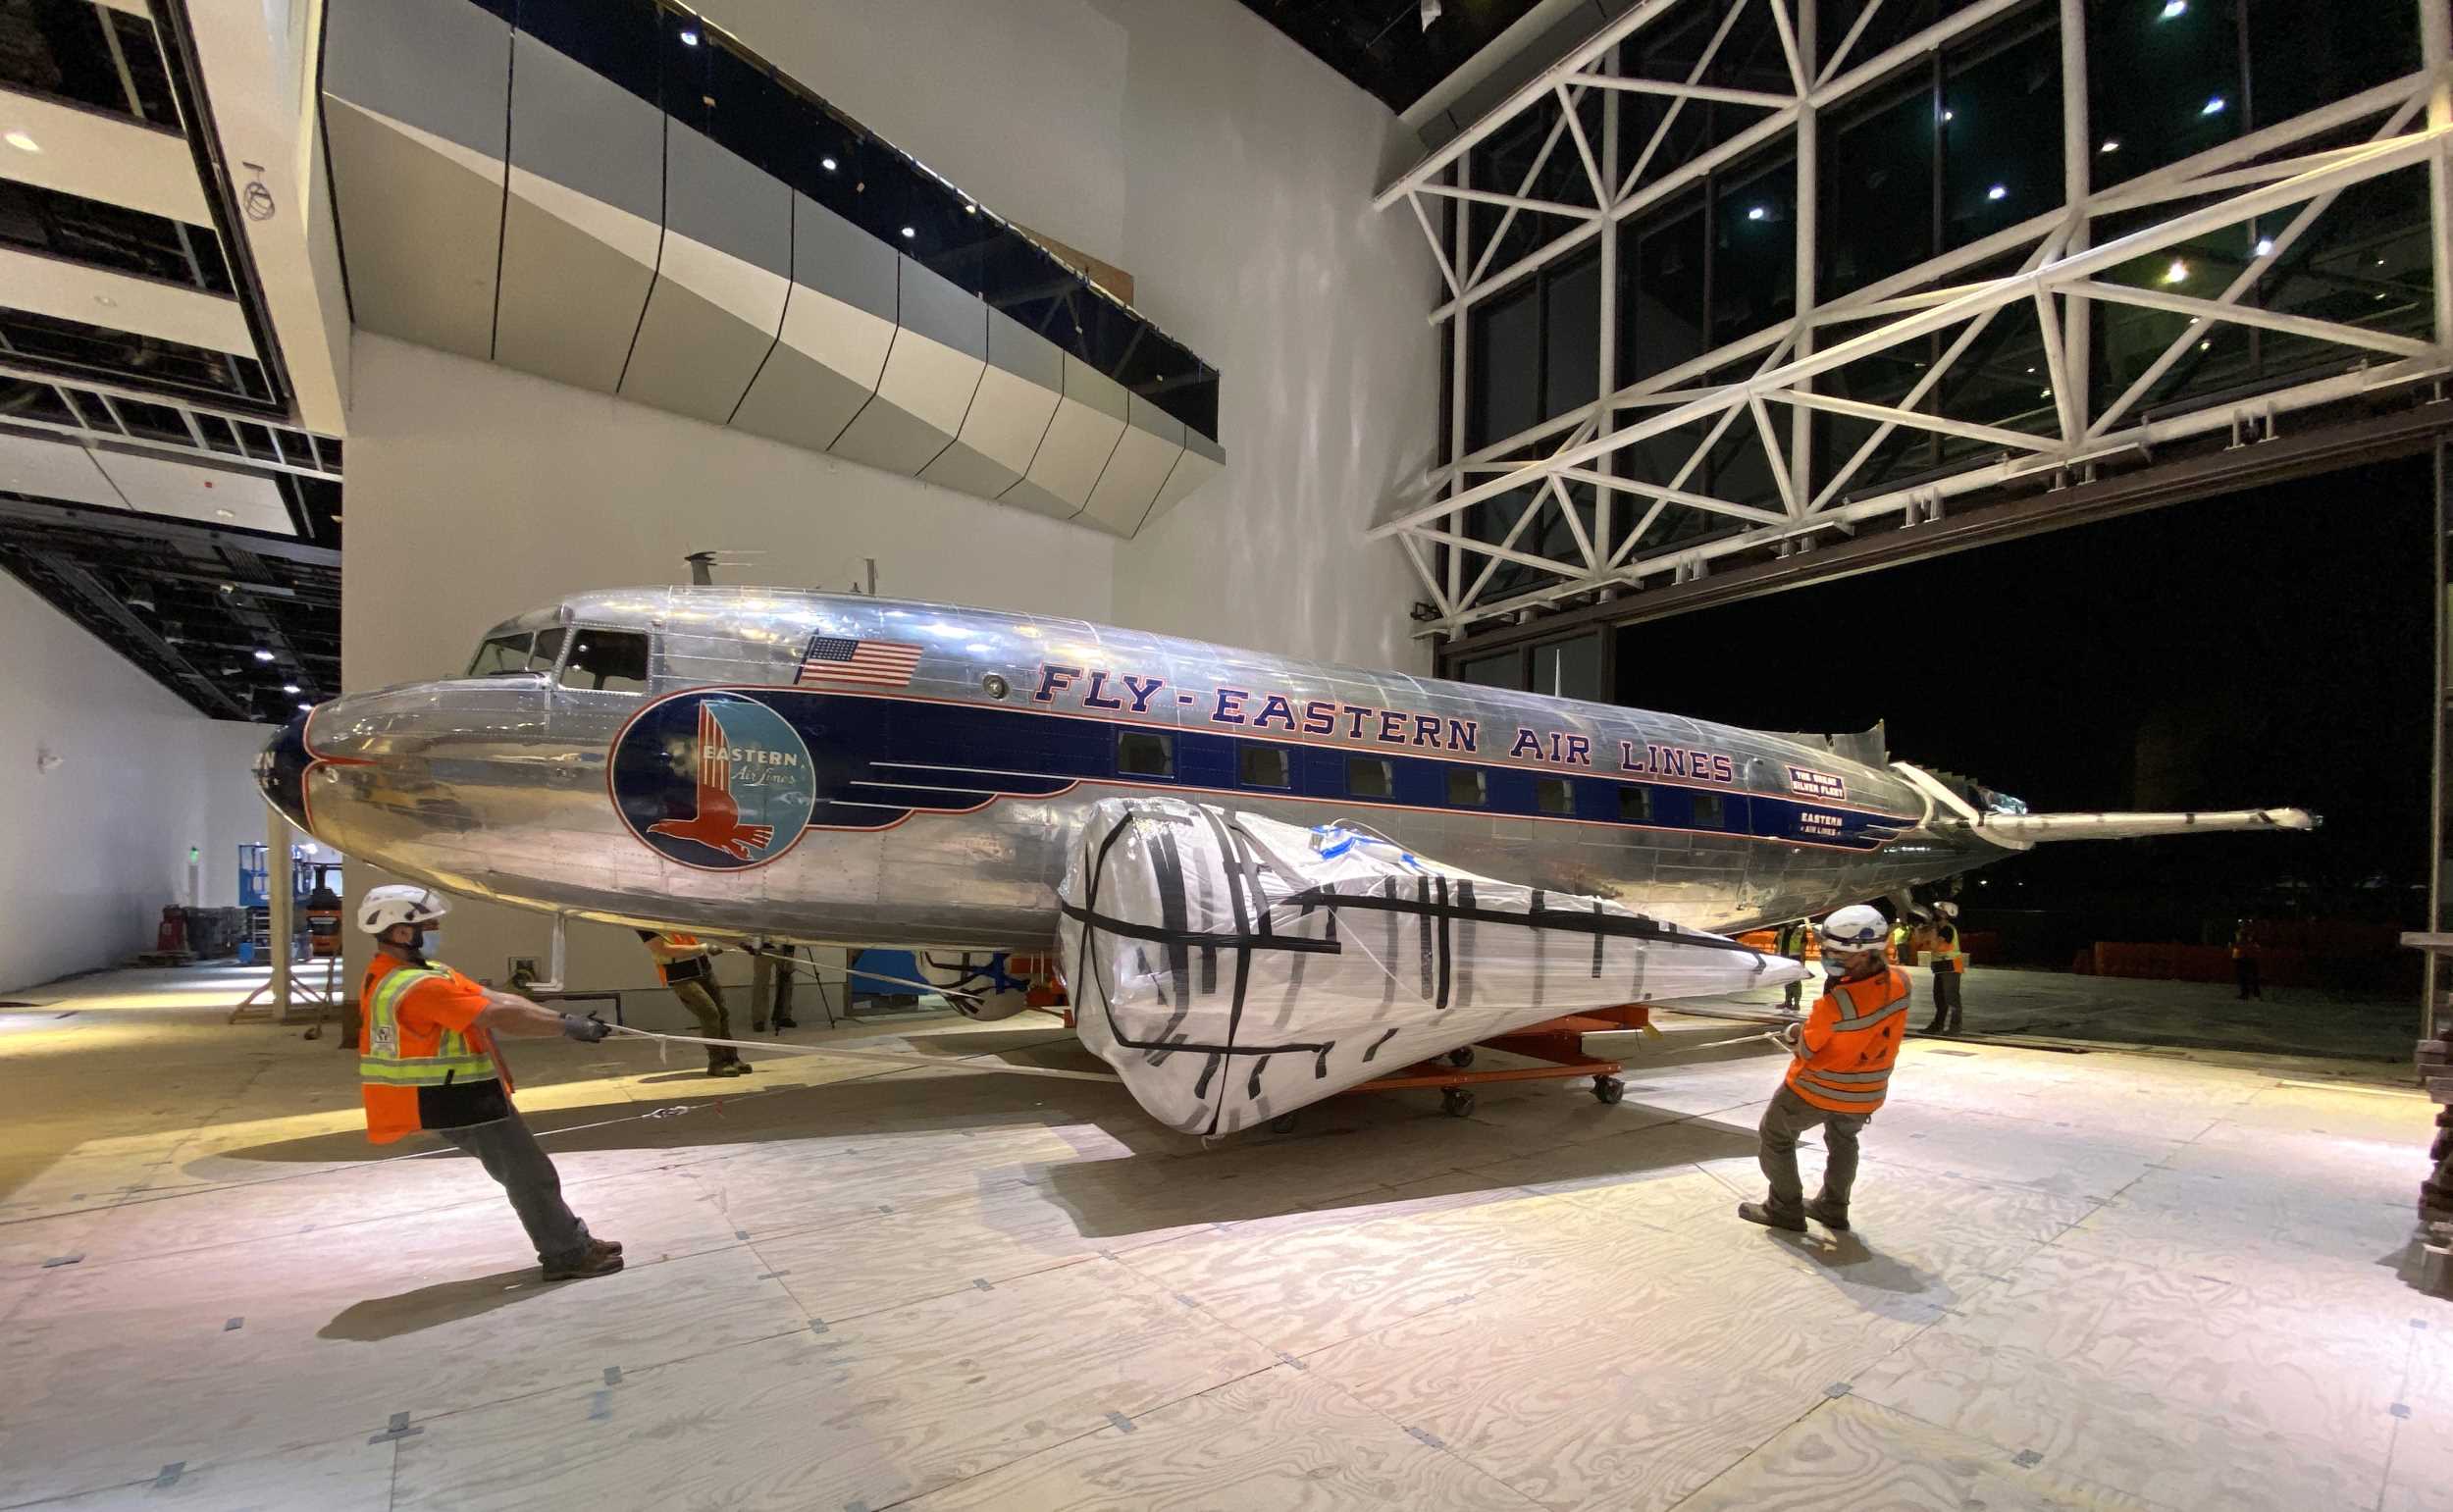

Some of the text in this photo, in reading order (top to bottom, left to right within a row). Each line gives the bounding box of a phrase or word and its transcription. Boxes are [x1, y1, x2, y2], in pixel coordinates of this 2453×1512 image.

[1033, 662, 1165, 714] FLY
[1211, 688, 1478, 753] EASTERN
[1508, 727, 1592, 765] AIR
[1620, 741, 1734, 783] LINES
[704, 745, 797, 765] EASTERN
[1801, 812, 1843, 826] EASTERN
